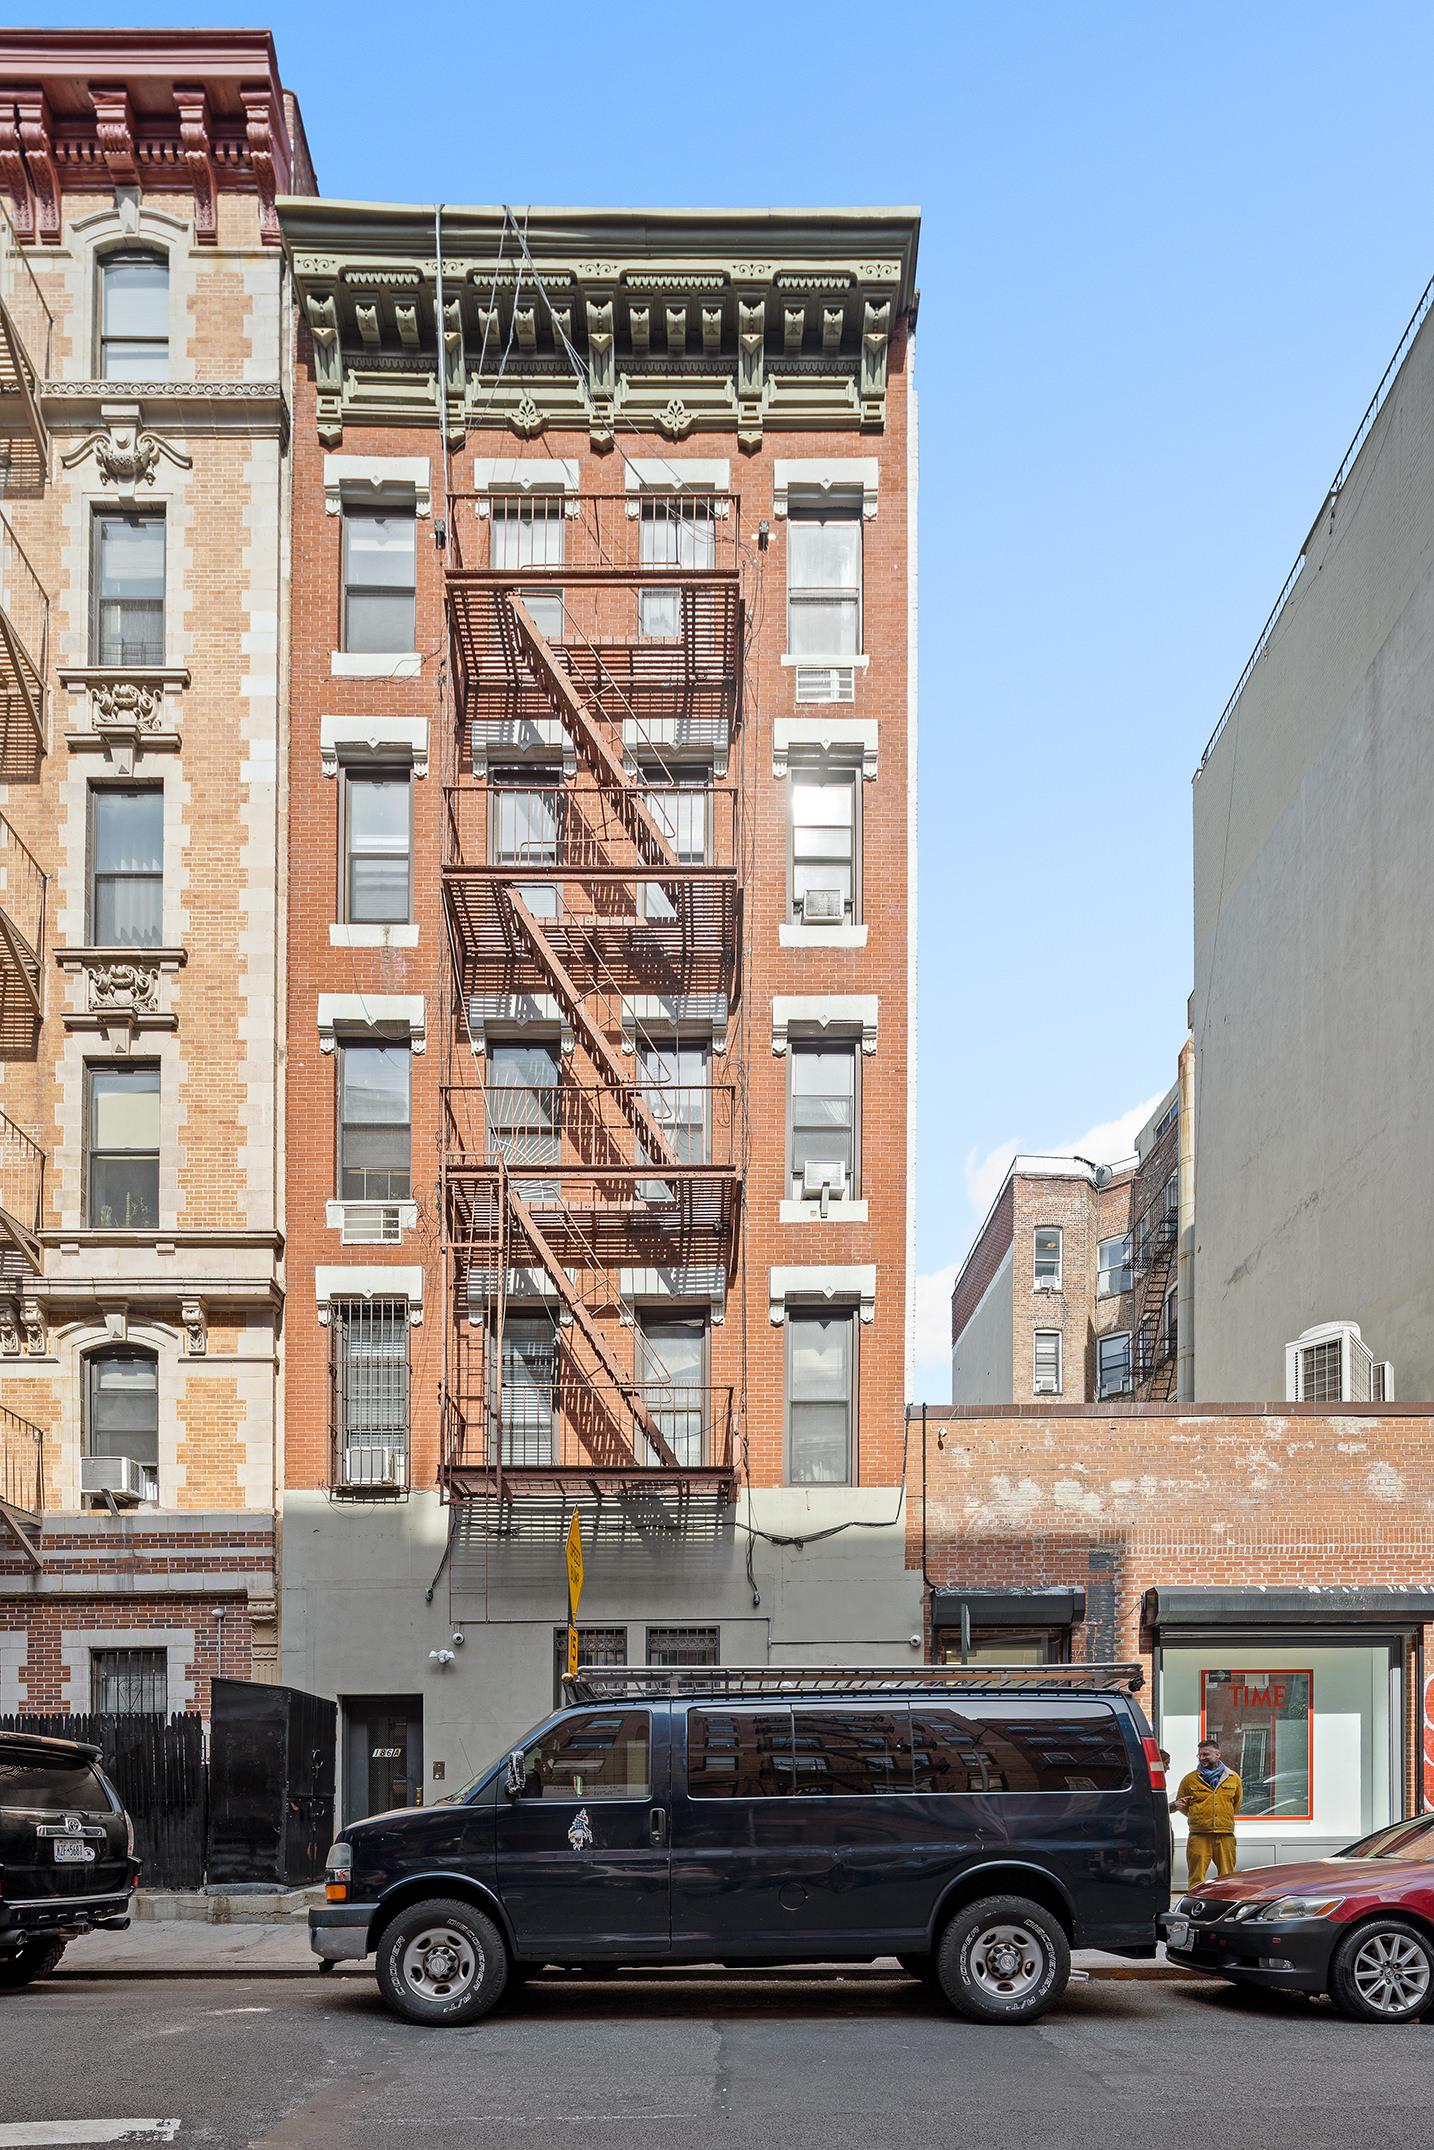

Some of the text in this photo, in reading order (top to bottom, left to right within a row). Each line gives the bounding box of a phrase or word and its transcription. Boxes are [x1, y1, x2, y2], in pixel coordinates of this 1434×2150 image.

[1228, 1685, 1286, 1707] TIME
[373, 1748, 401, 1757] 186A
[390, 1935, 405, 1996] COOPER
[447, 1918, 485, 1991] DISCOVERER
[960, 1926, 980, 1985] COOPER
[1023, 1919, 1056, 1996] DISCOVERER
